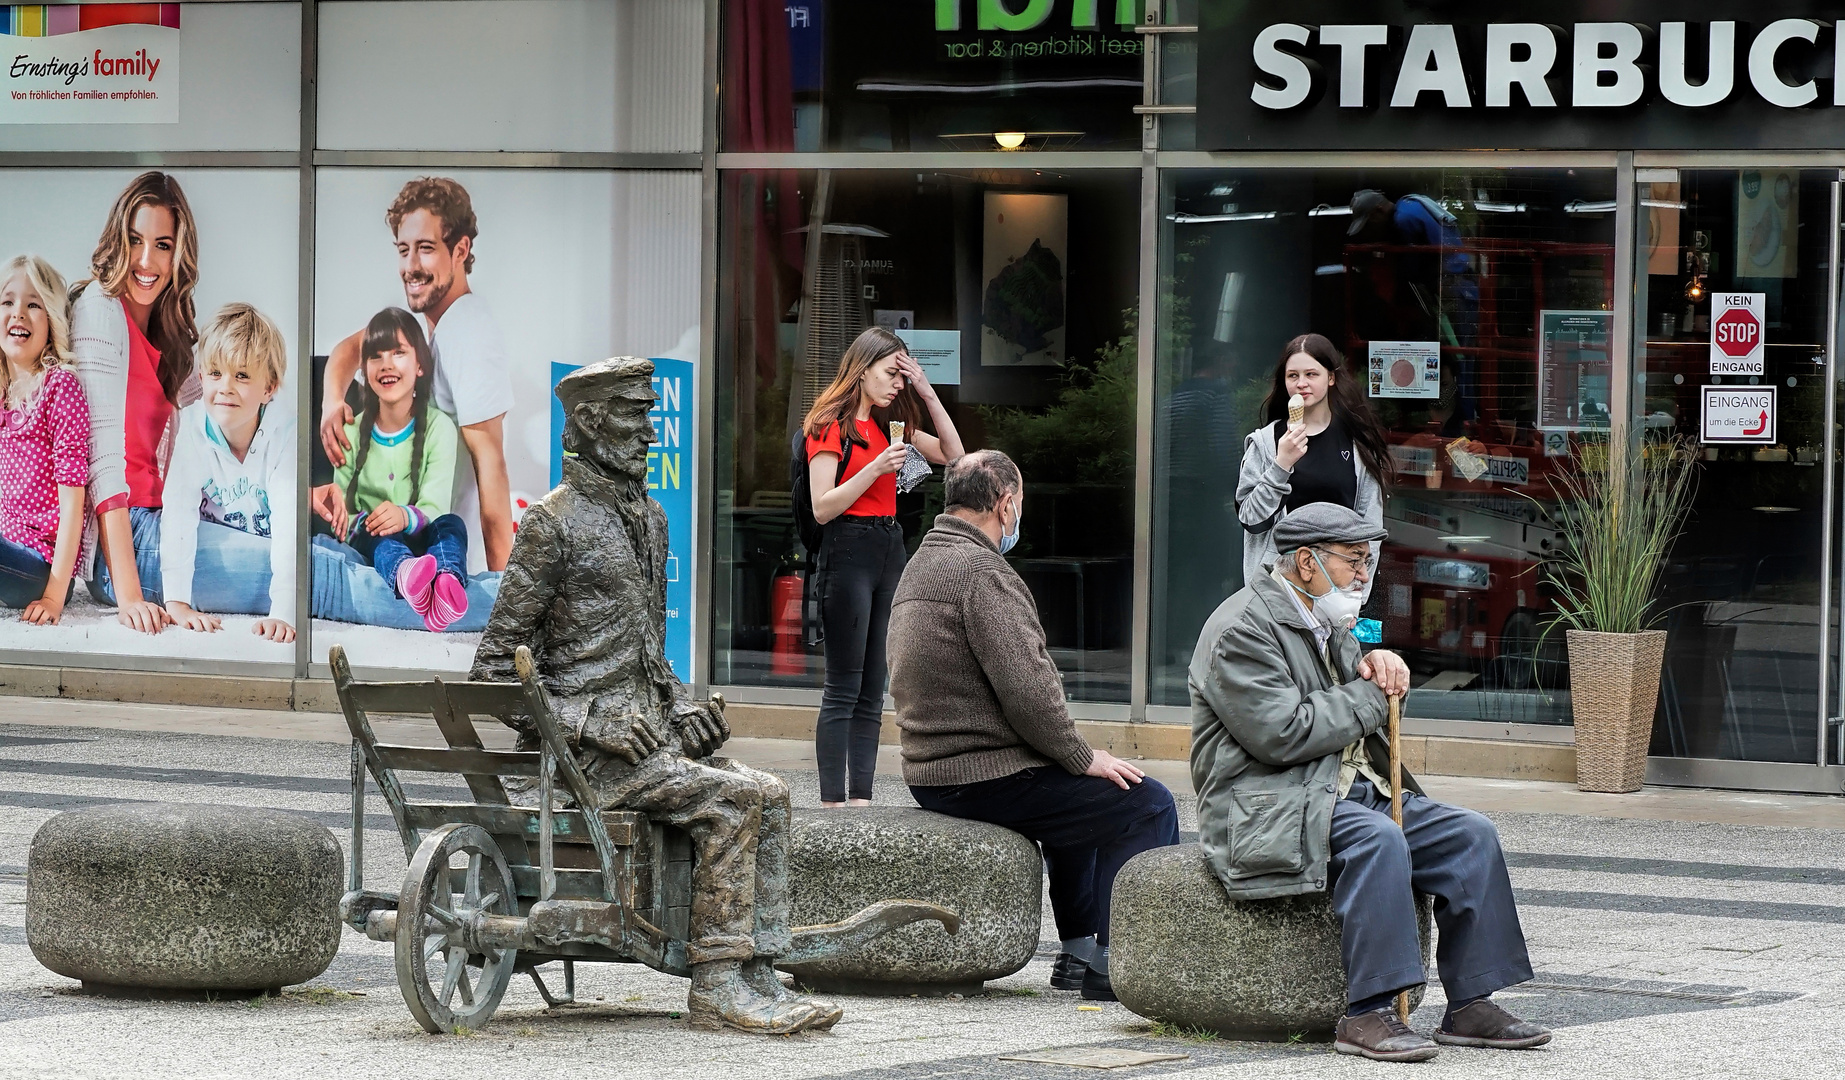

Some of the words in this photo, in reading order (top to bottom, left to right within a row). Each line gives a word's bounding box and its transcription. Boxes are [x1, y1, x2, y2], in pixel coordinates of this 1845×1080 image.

[10, 54, 89, 86] Ernsting's
[93, 48, 161, 82] family
[1250, 18, 1845, 109] STARBUC
[11, 90, 27, 100] Von
[29, 90, 71, 100] fröhlichen
[73, 90, 108, 100] Familien
[110, 89, 159, 101] empfohlen.
[1724, 295, 1752, 306] KEIN
[1718, 322, 1757, 343] STOP
[1711, 362, 1763, 373] EINGANG
[1709, 396, 1769, 408] EINGANG
[1709, 418, 1722, 427] um
[1724, 417, 1737, 426] die
[1738, 417, 1759, 427] Ecke
[646, 452, 680, 490] EN
[666, 607, 679, 619] rei
